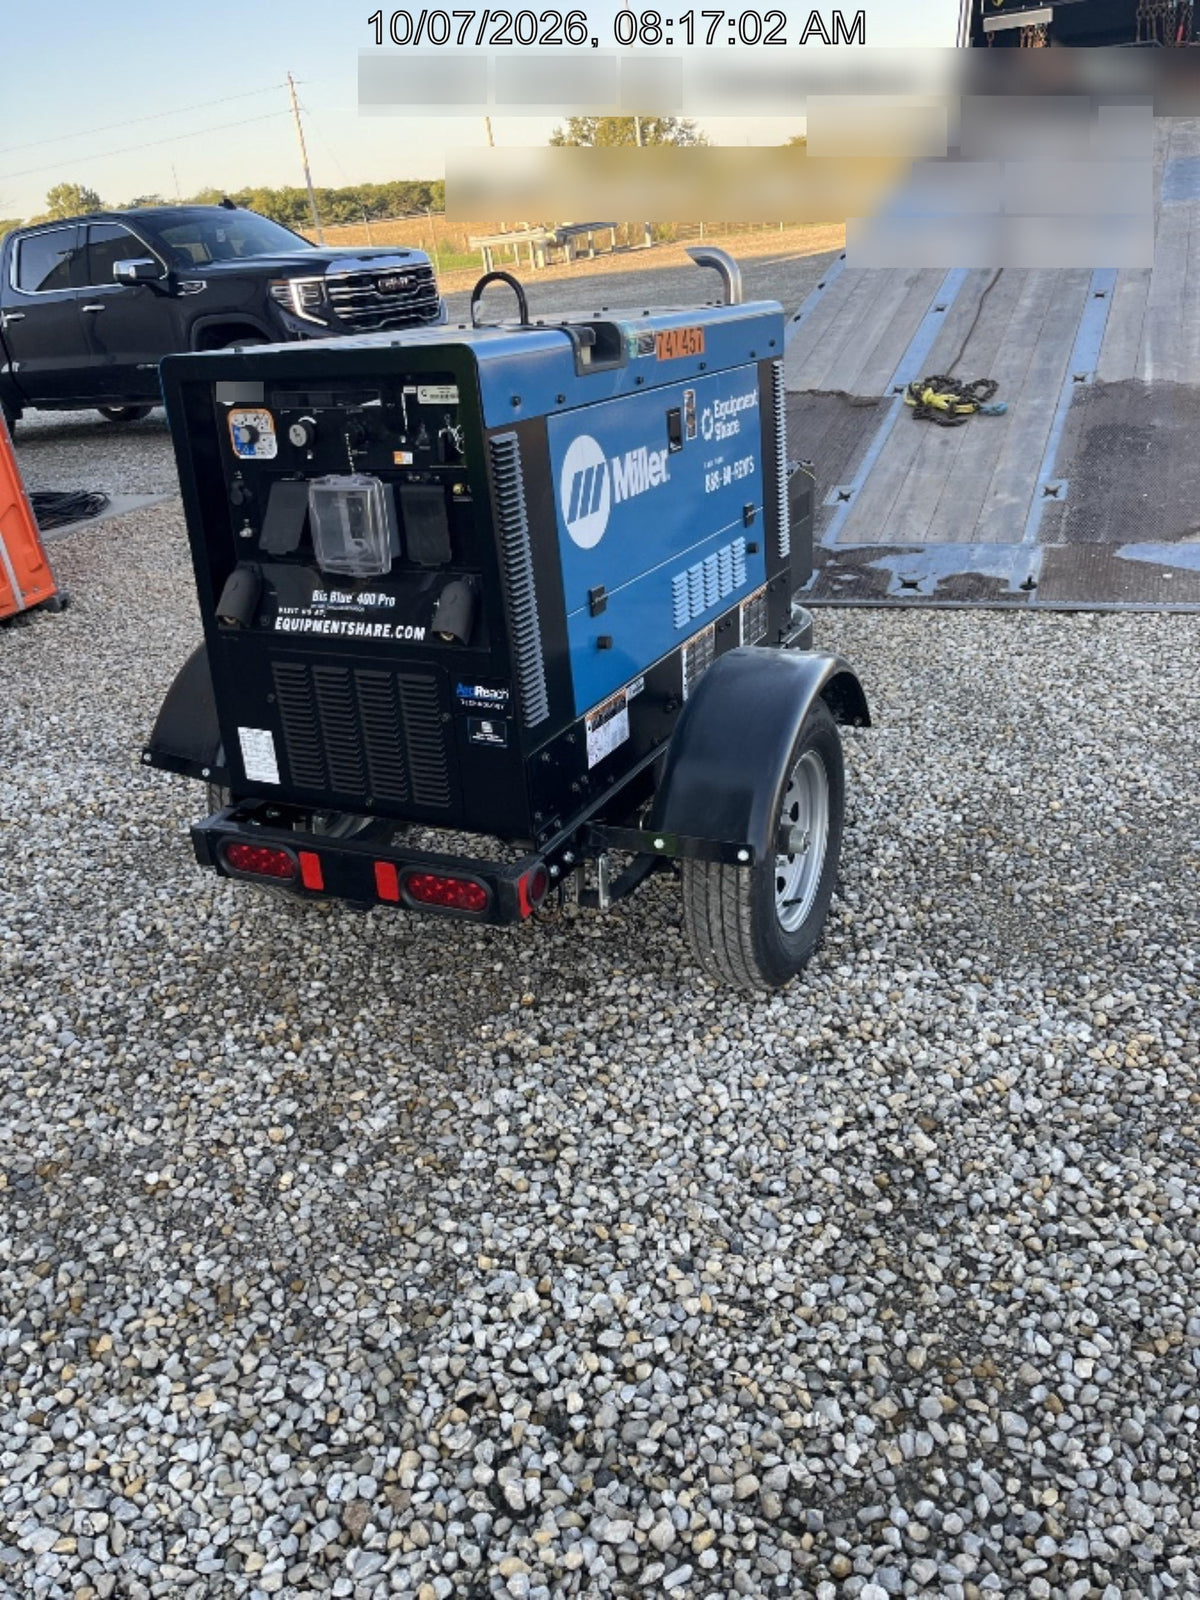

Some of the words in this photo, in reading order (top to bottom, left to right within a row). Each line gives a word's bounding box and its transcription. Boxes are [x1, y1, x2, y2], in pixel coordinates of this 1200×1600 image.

[714, 388, 758, 420] Equipment
[714, 419, 740, 441] Share
[612, 446, 670, 504] Miller
[330, 591, 353, 604] Blue
[378, 593, 396, 607] Pro
[274, 616, 426, 641] EQUIPMENTSHARE.COM
